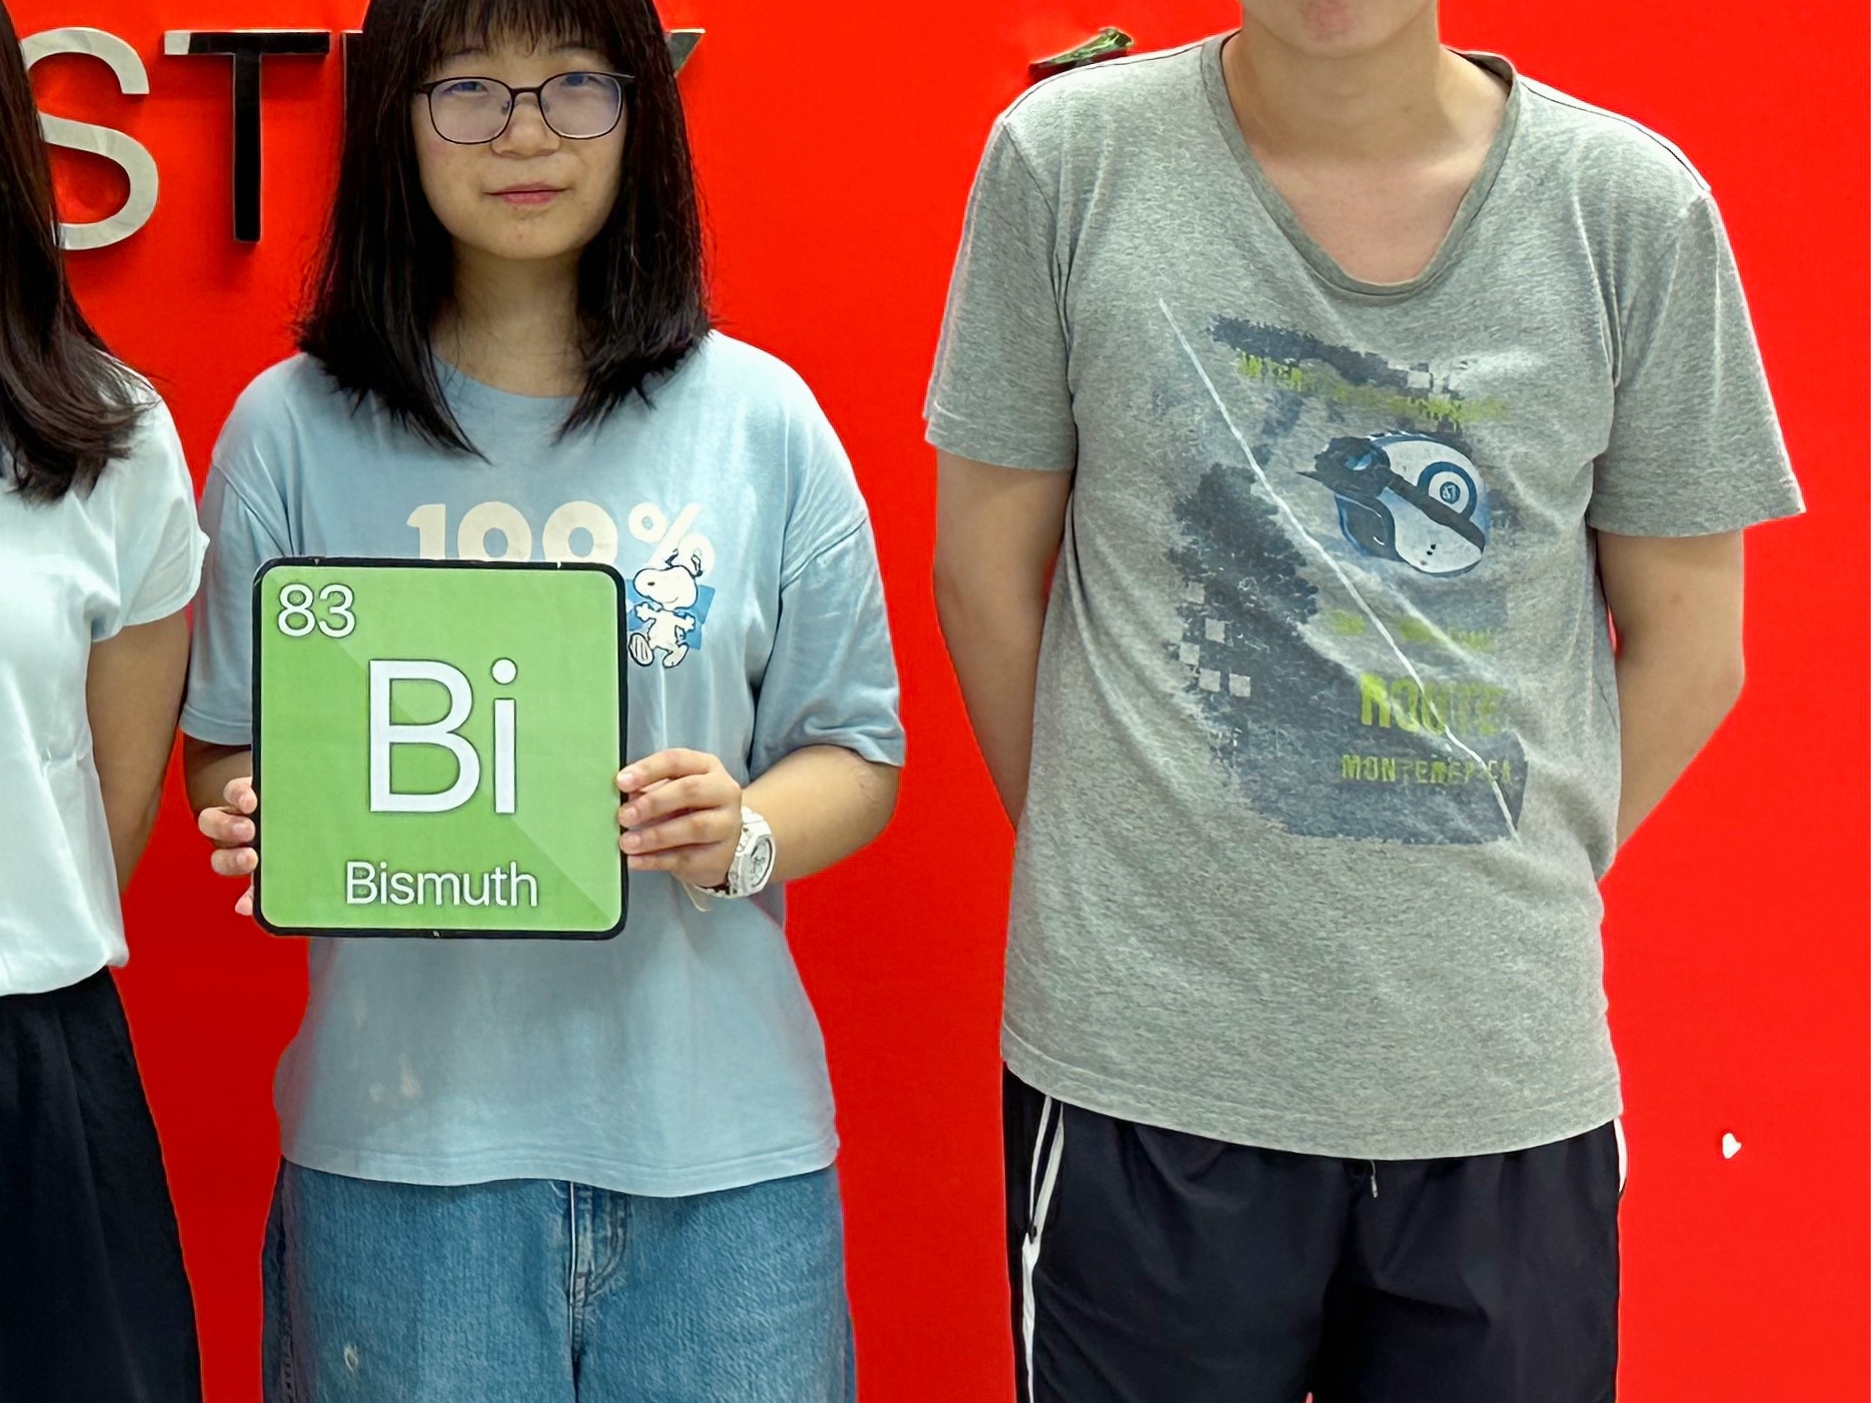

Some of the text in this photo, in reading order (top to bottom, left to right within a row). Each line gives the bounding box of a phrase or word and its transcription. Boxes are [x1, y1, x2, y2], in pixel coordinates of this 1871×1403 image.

[406, 500, 715, 580] 100%
[277, 583, 356, 638] 83
[368, 657, 518, 814] Bi
[345, 860, 539, 909] Bismuth
